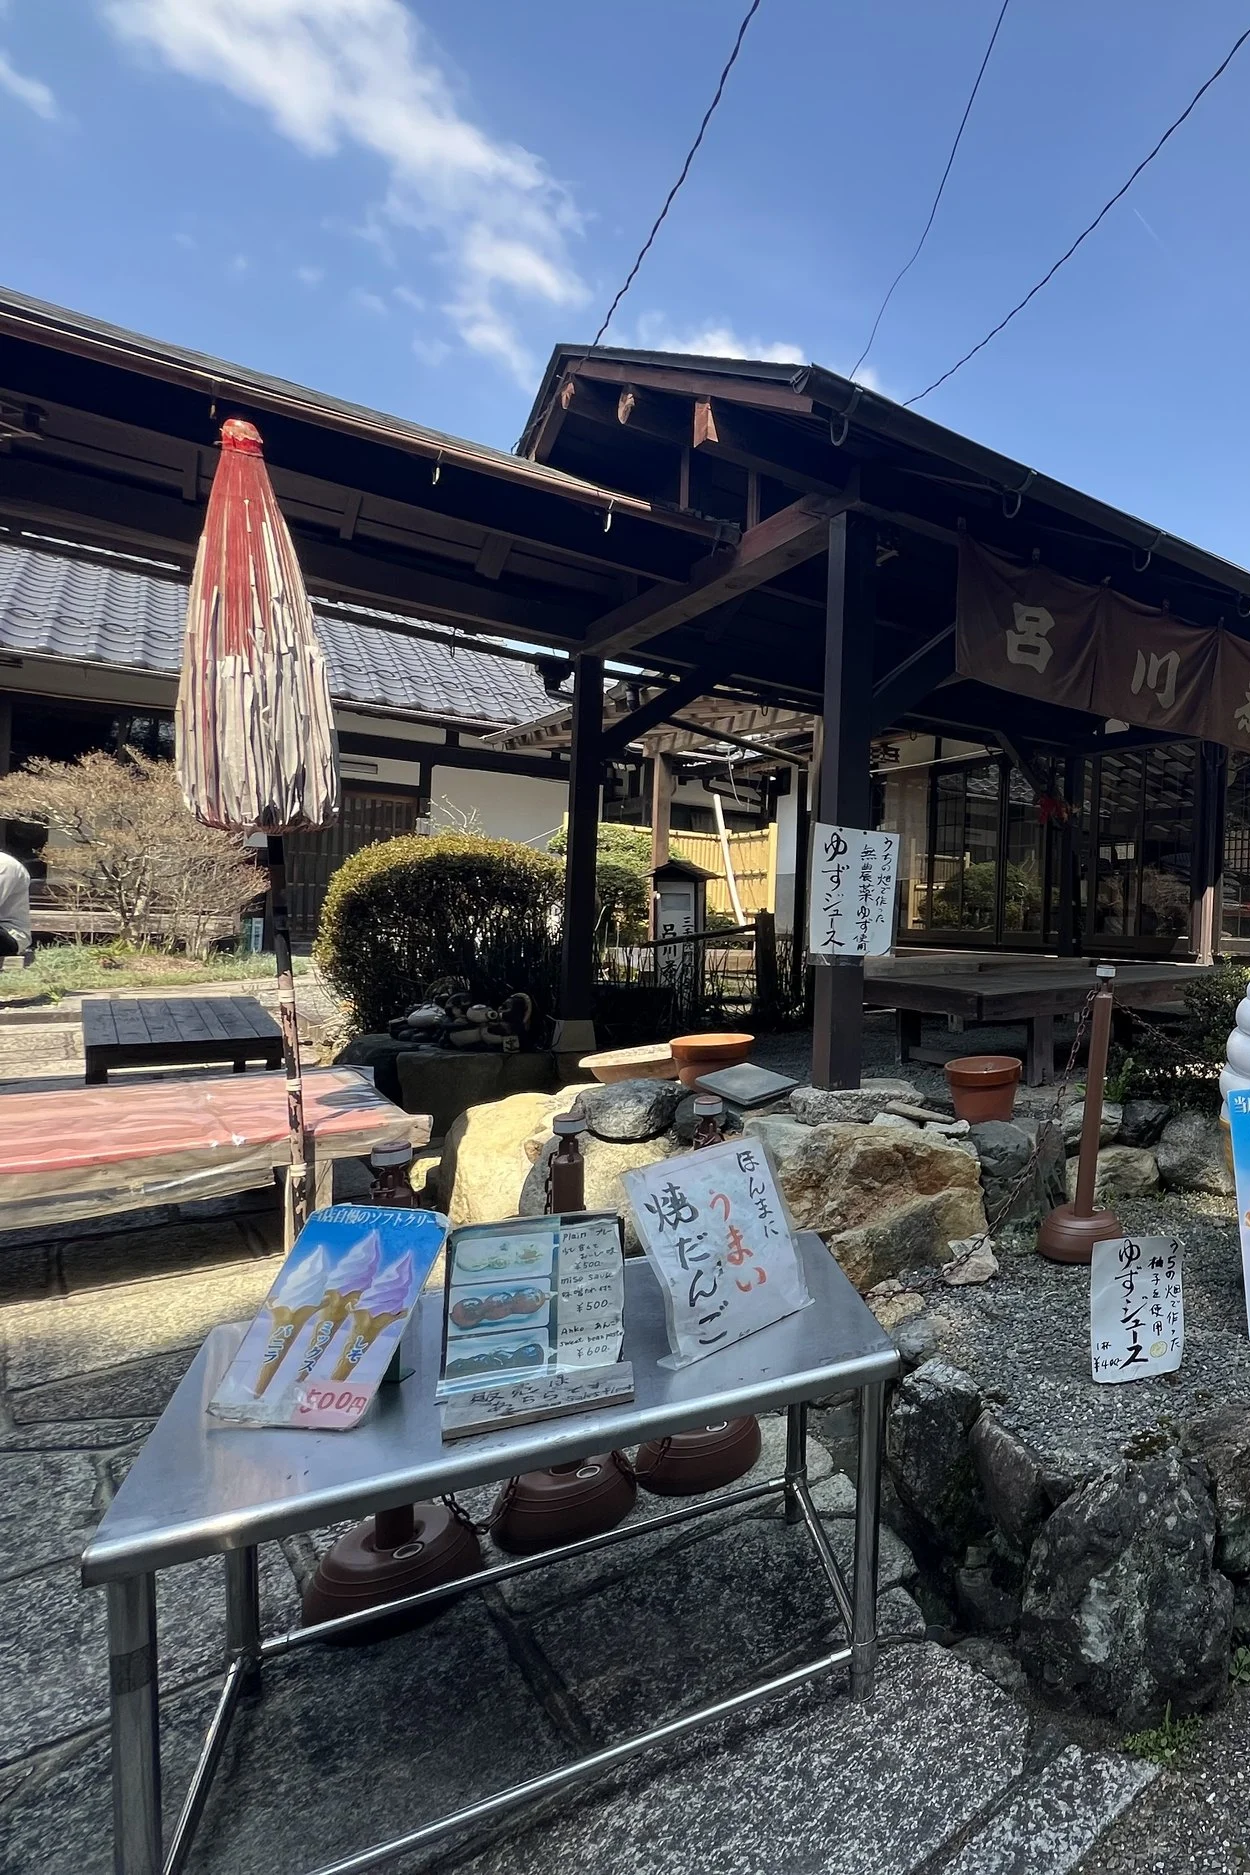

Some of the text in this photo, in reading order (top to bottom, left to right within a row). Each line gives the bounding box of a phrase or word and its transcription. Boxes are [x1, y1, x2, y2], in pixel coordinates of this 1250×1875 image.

[820, 832, 850, 947] ゆずジュース
[736, 1151, 779, 1238] ほんまに
[644, 1182, 729, 1344] 焼だんご
[709, 1189, 767, 1292] うまい
[263, 1324, 293, 1363] バニラ
[301, 1321, 334, 1372] ミックス
[1114, 1238, 1149, 1370] ゆずジュース
[346, 1335, 369, 1363] しそ
[299, 1389, 368, 1415] 500円
